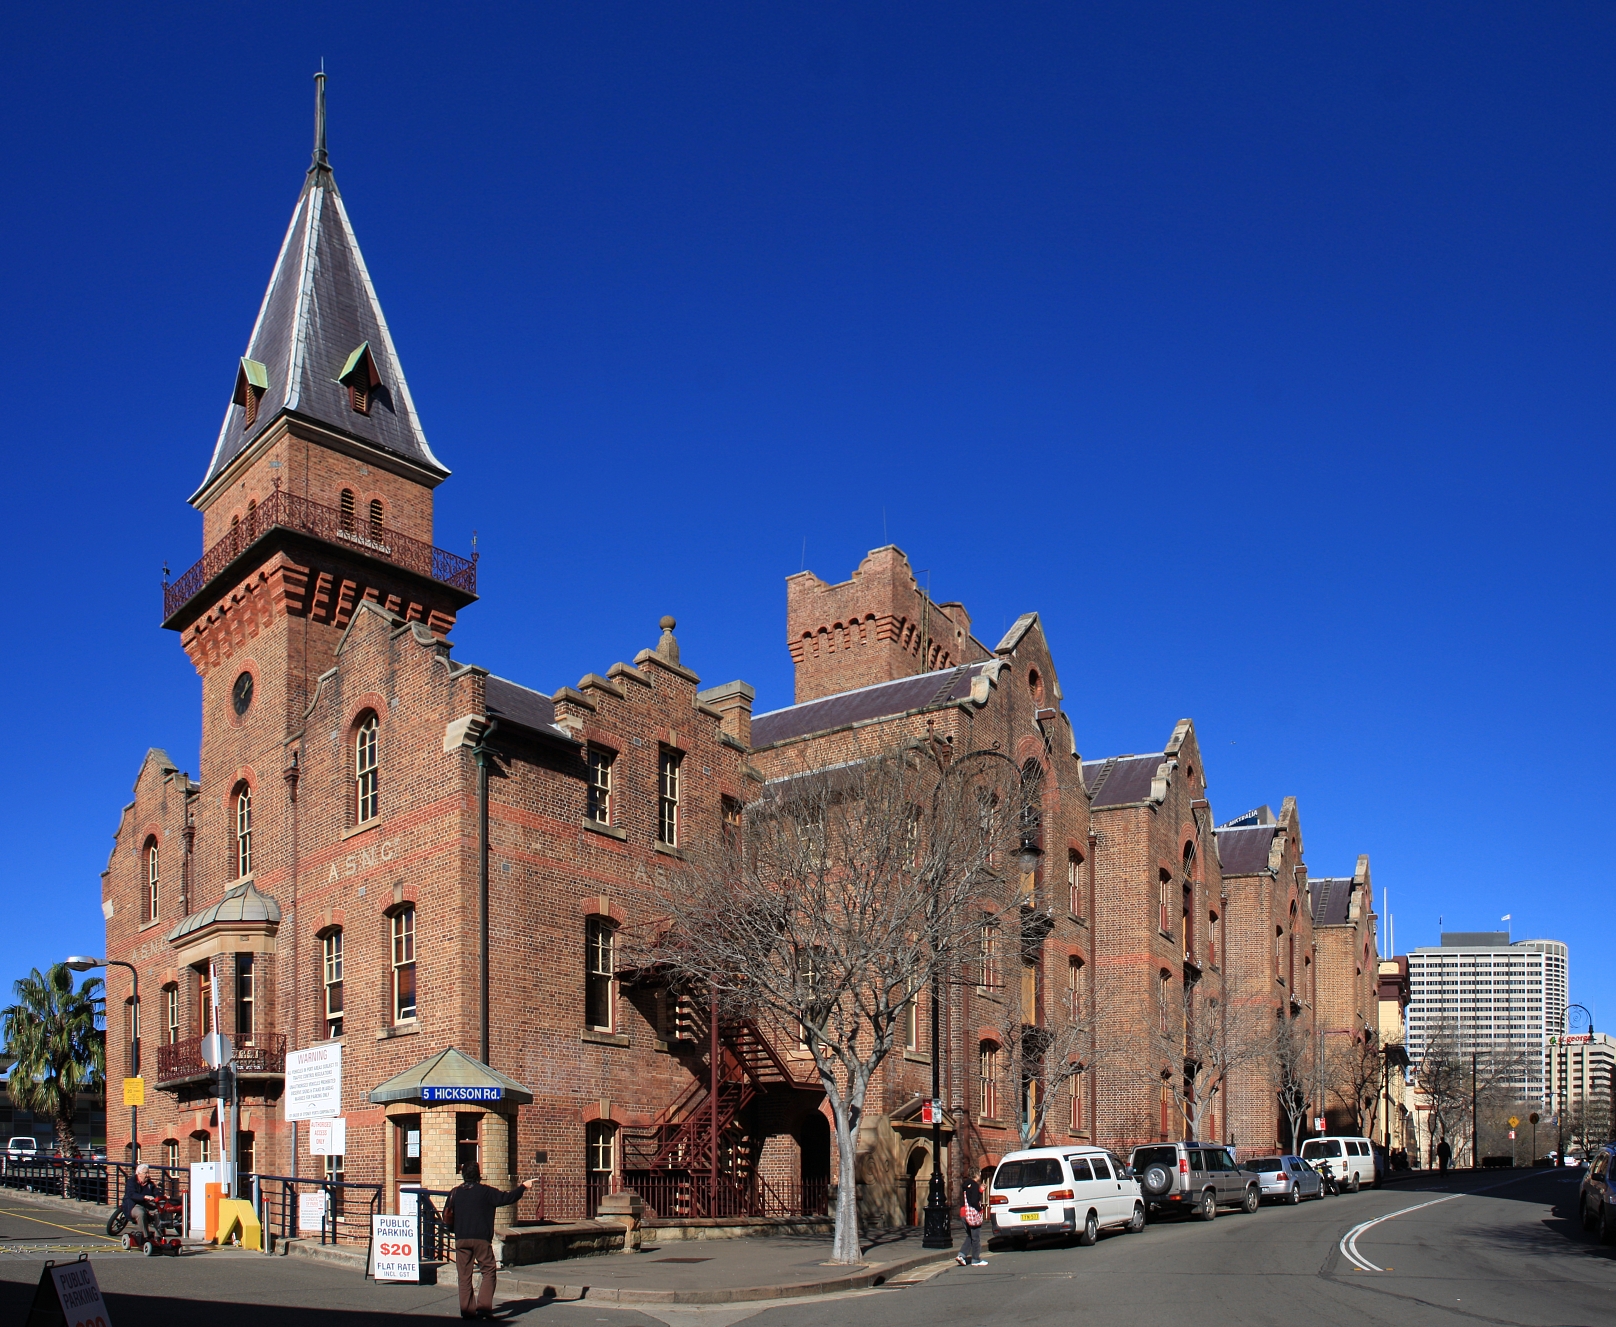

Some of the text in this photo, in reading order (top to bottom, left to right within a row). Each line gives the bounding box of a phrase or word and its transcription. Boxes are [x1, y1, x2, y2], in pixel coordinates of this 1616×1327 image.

[298, 1050, 327, 1064] WARNING
[423, 1088, 500, 1099] 5 HICKSON Rd.
[380, 1218, 410, 1228] PUBLIC
[377, 1228, 414, 1237] PARKING
[380, 1242, 412, 1256] $20
[60, 1269, 90, 1290] PUBLIC
[62, 1286, 99, 1310] PARKING
